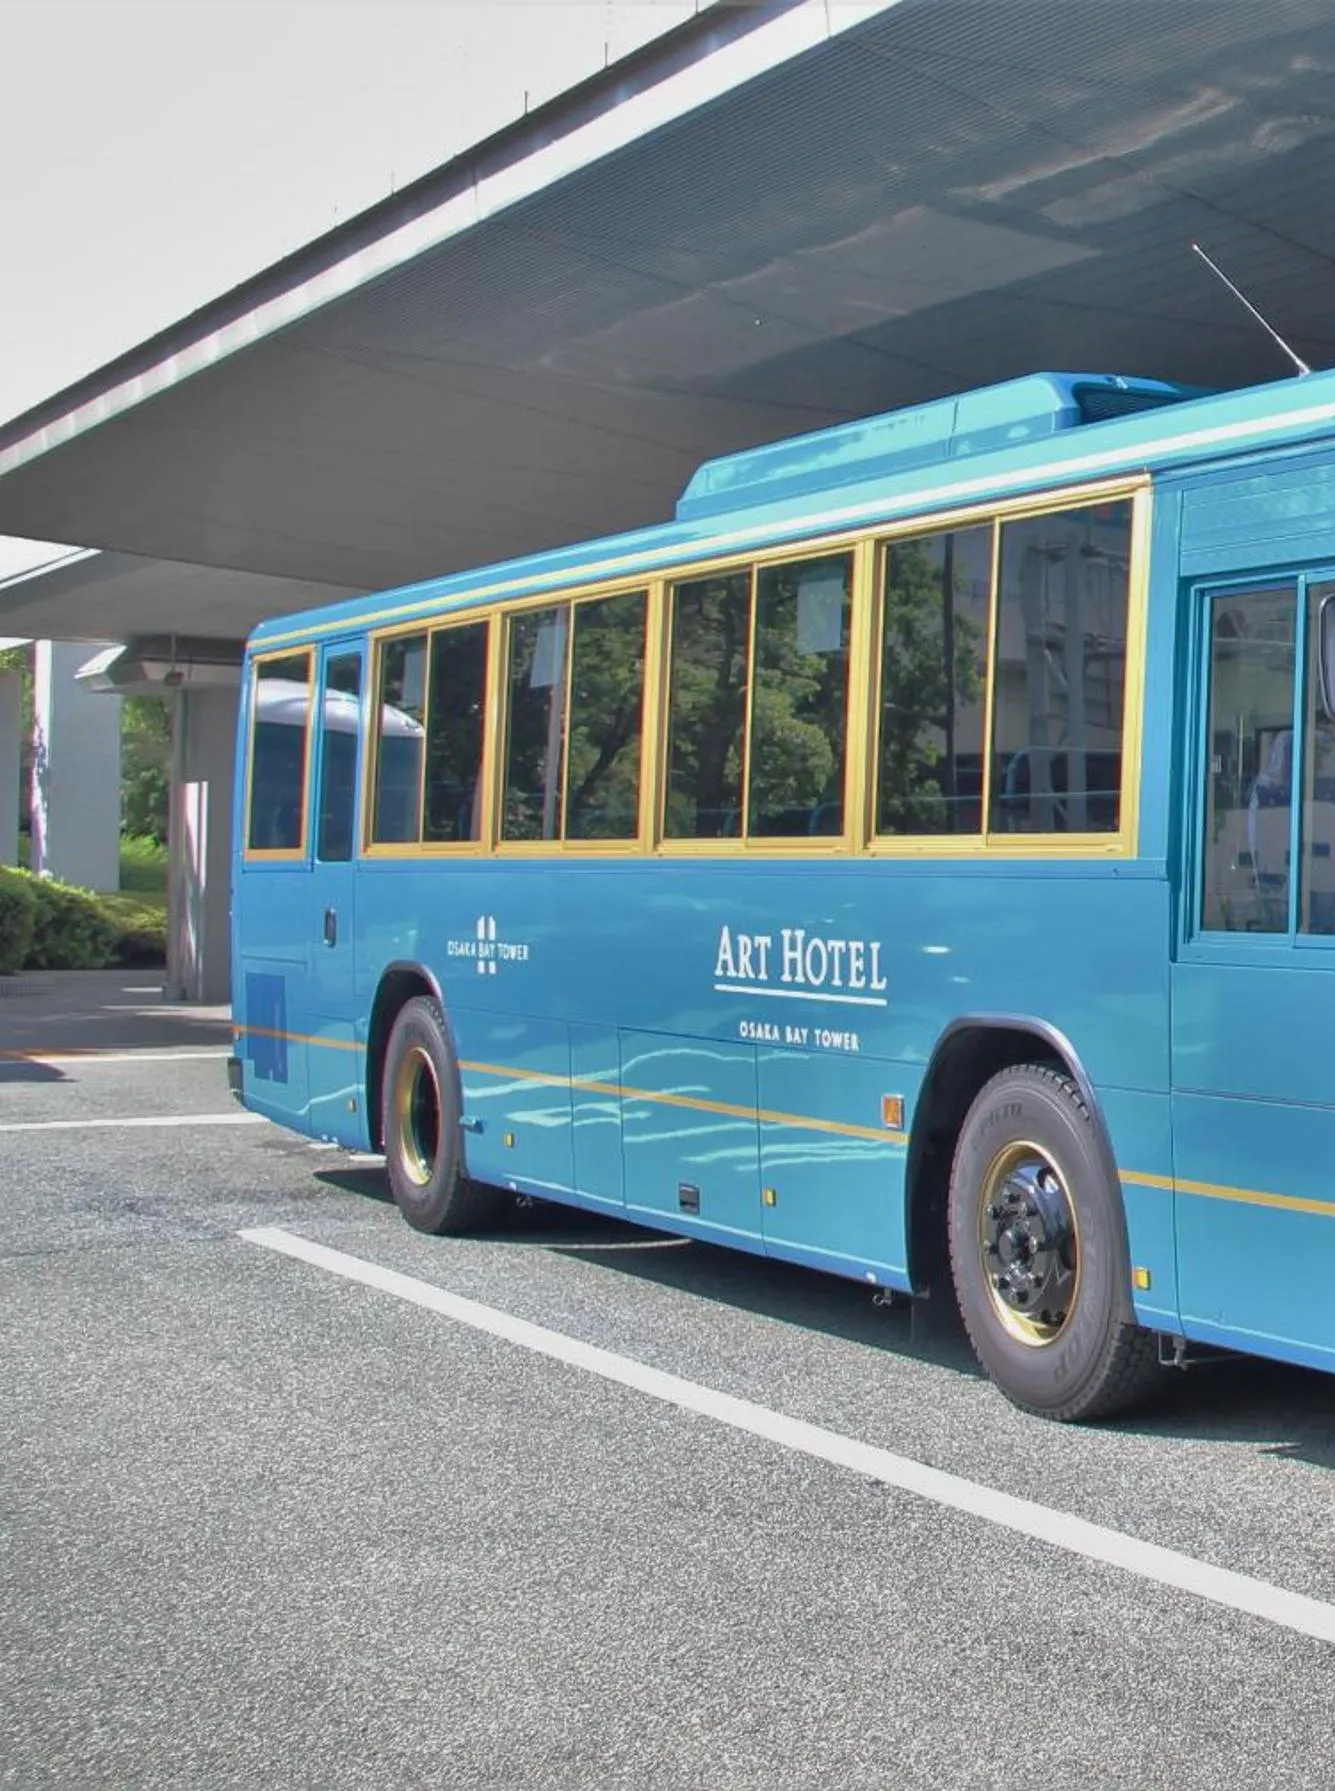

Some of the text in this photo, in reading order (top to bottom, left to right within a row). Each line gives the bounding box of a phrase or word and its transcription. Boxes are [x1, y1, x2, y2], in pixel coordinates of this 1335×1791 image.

[447, 940, 529, 961] OSAKA BAY TOWER
[739, 1020, 860, 1051] OSAKA BAY TOWER
